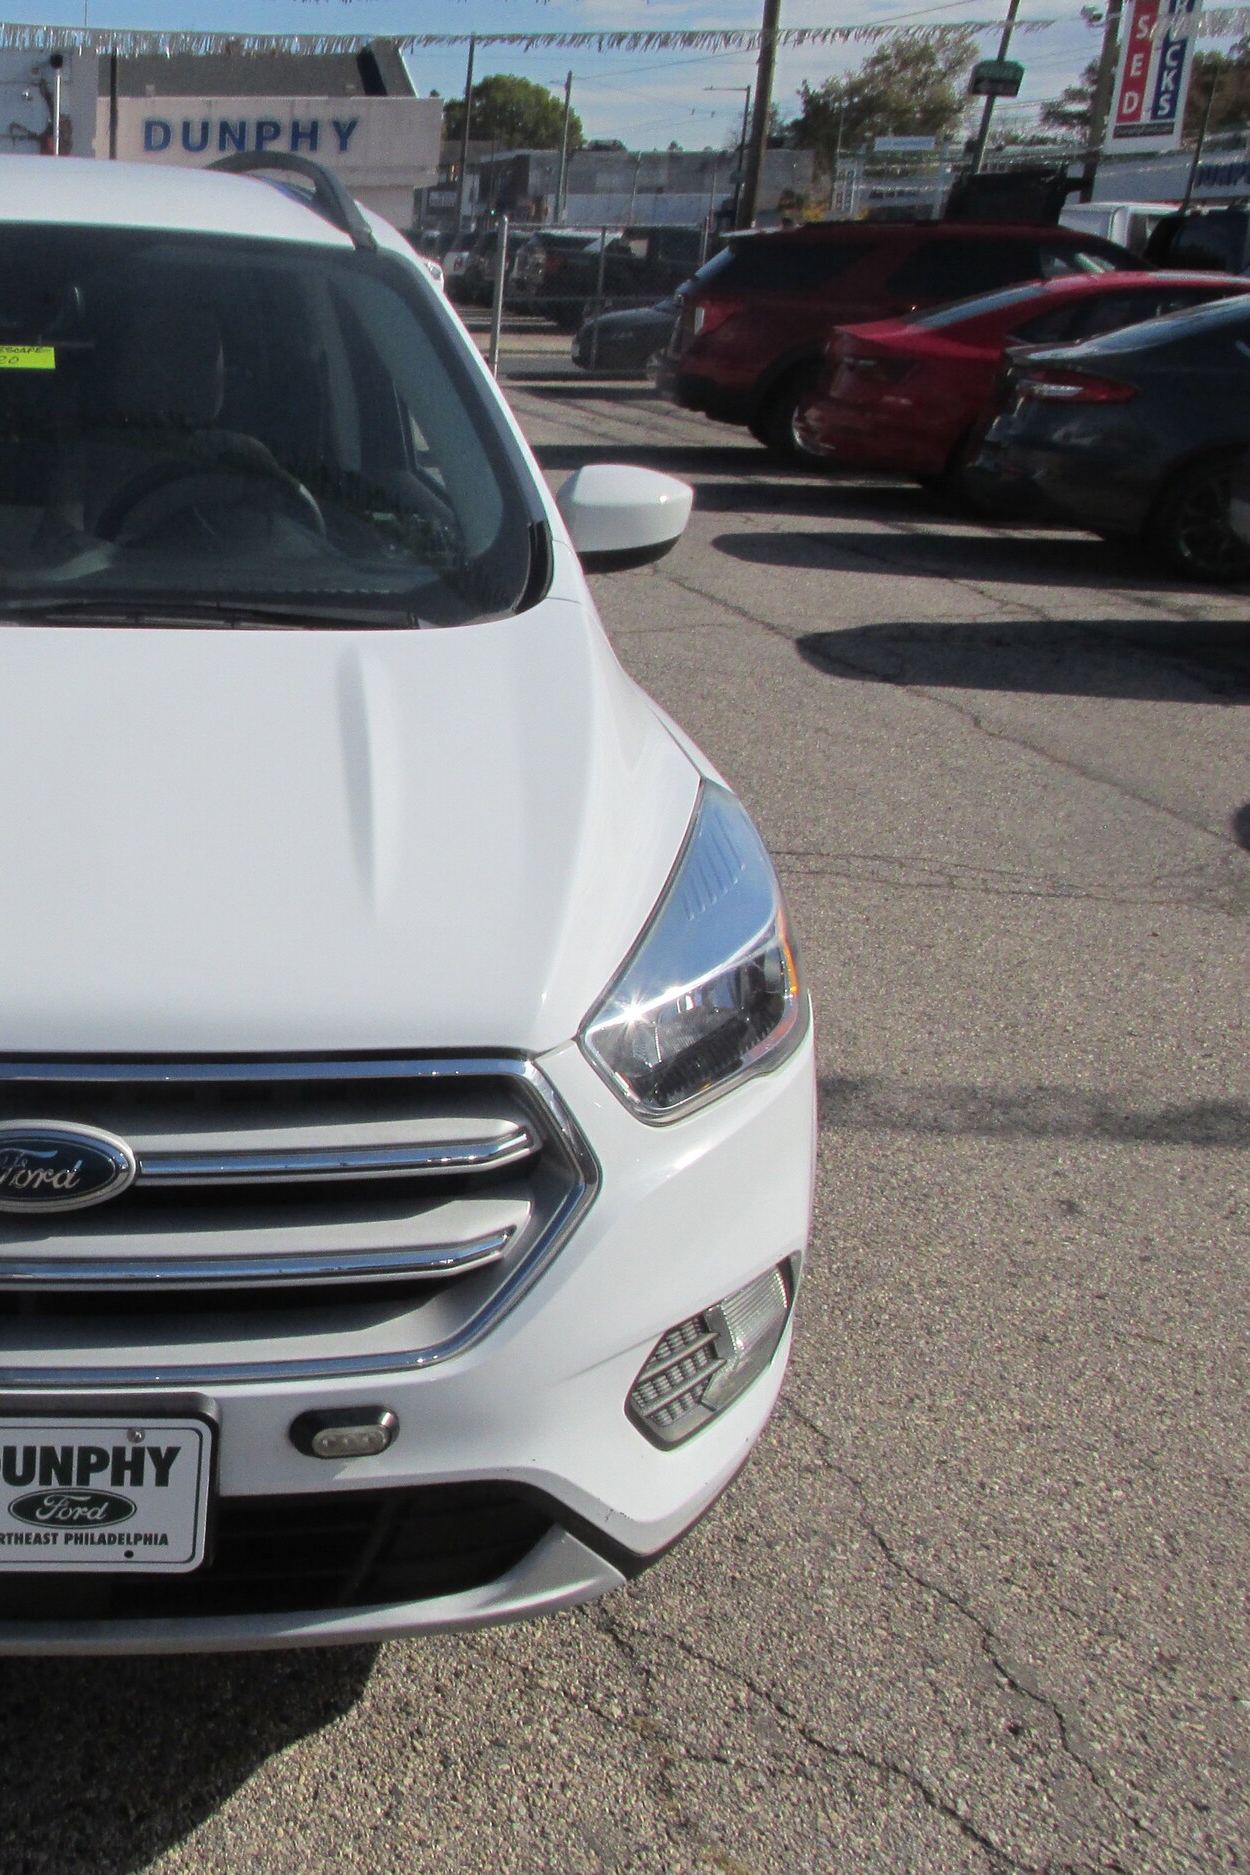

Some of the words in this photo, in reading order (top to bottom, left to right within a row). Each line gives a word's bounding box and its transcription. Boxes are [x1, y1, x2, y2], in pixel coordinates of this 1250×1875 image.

[143, 119, 358, 152] DUNPHY
[35, 1494, 111, 1521] Ford
[63, 1532, 169, 1547] PHILADELPHIA
